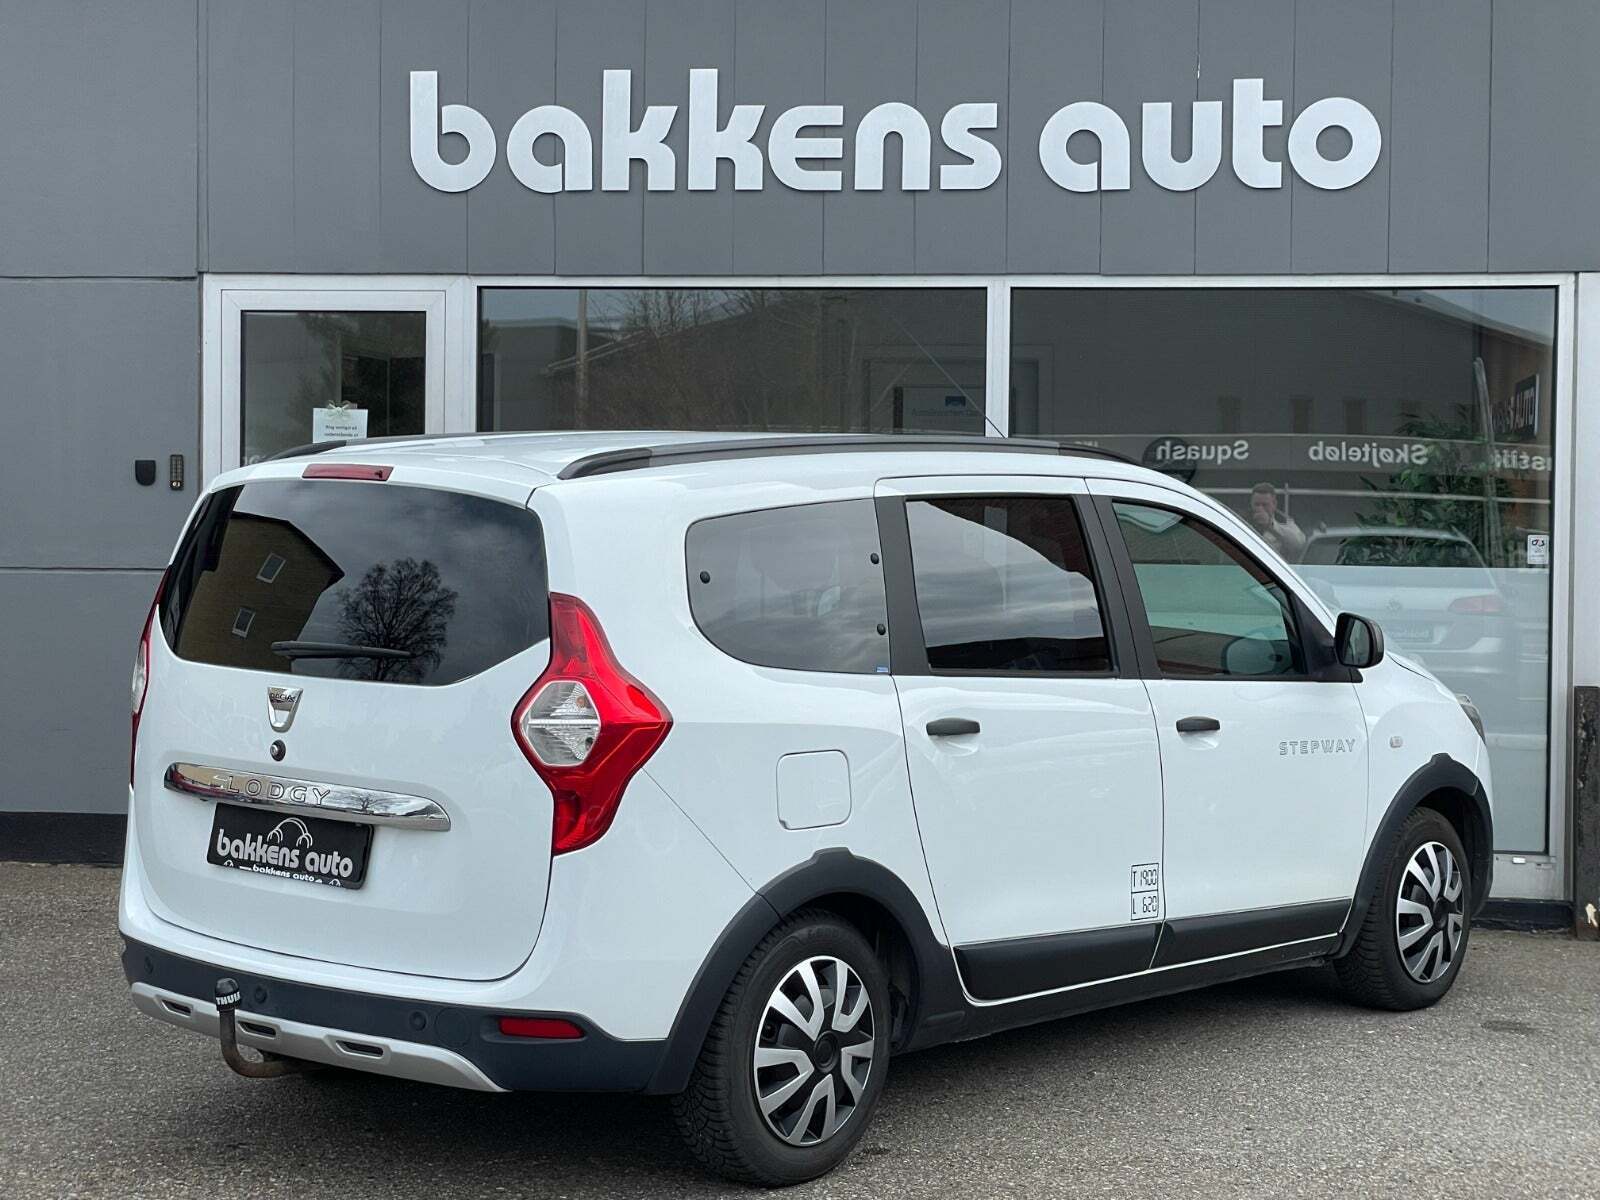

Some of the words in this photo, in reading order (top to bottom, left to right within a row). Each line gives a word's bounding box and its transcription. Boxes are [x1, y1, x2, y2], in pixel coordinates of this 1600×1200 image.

[410, 68, 1002, 193] bakkens
[1039, 78, 1382, 193] auto
[1279, 738, 1356, 756] STEPWAY
[226, 776, 331, 805] LODGY
[216, 828, 300, 869] bakkens
[304, 851, 353, 878] auto
[252, 864, 290, 878] bakkens
[292, 873, 315, 882] auto
[1140, 869, 1157, 887] 1900
[1142, 895, 1157, 913] 620
